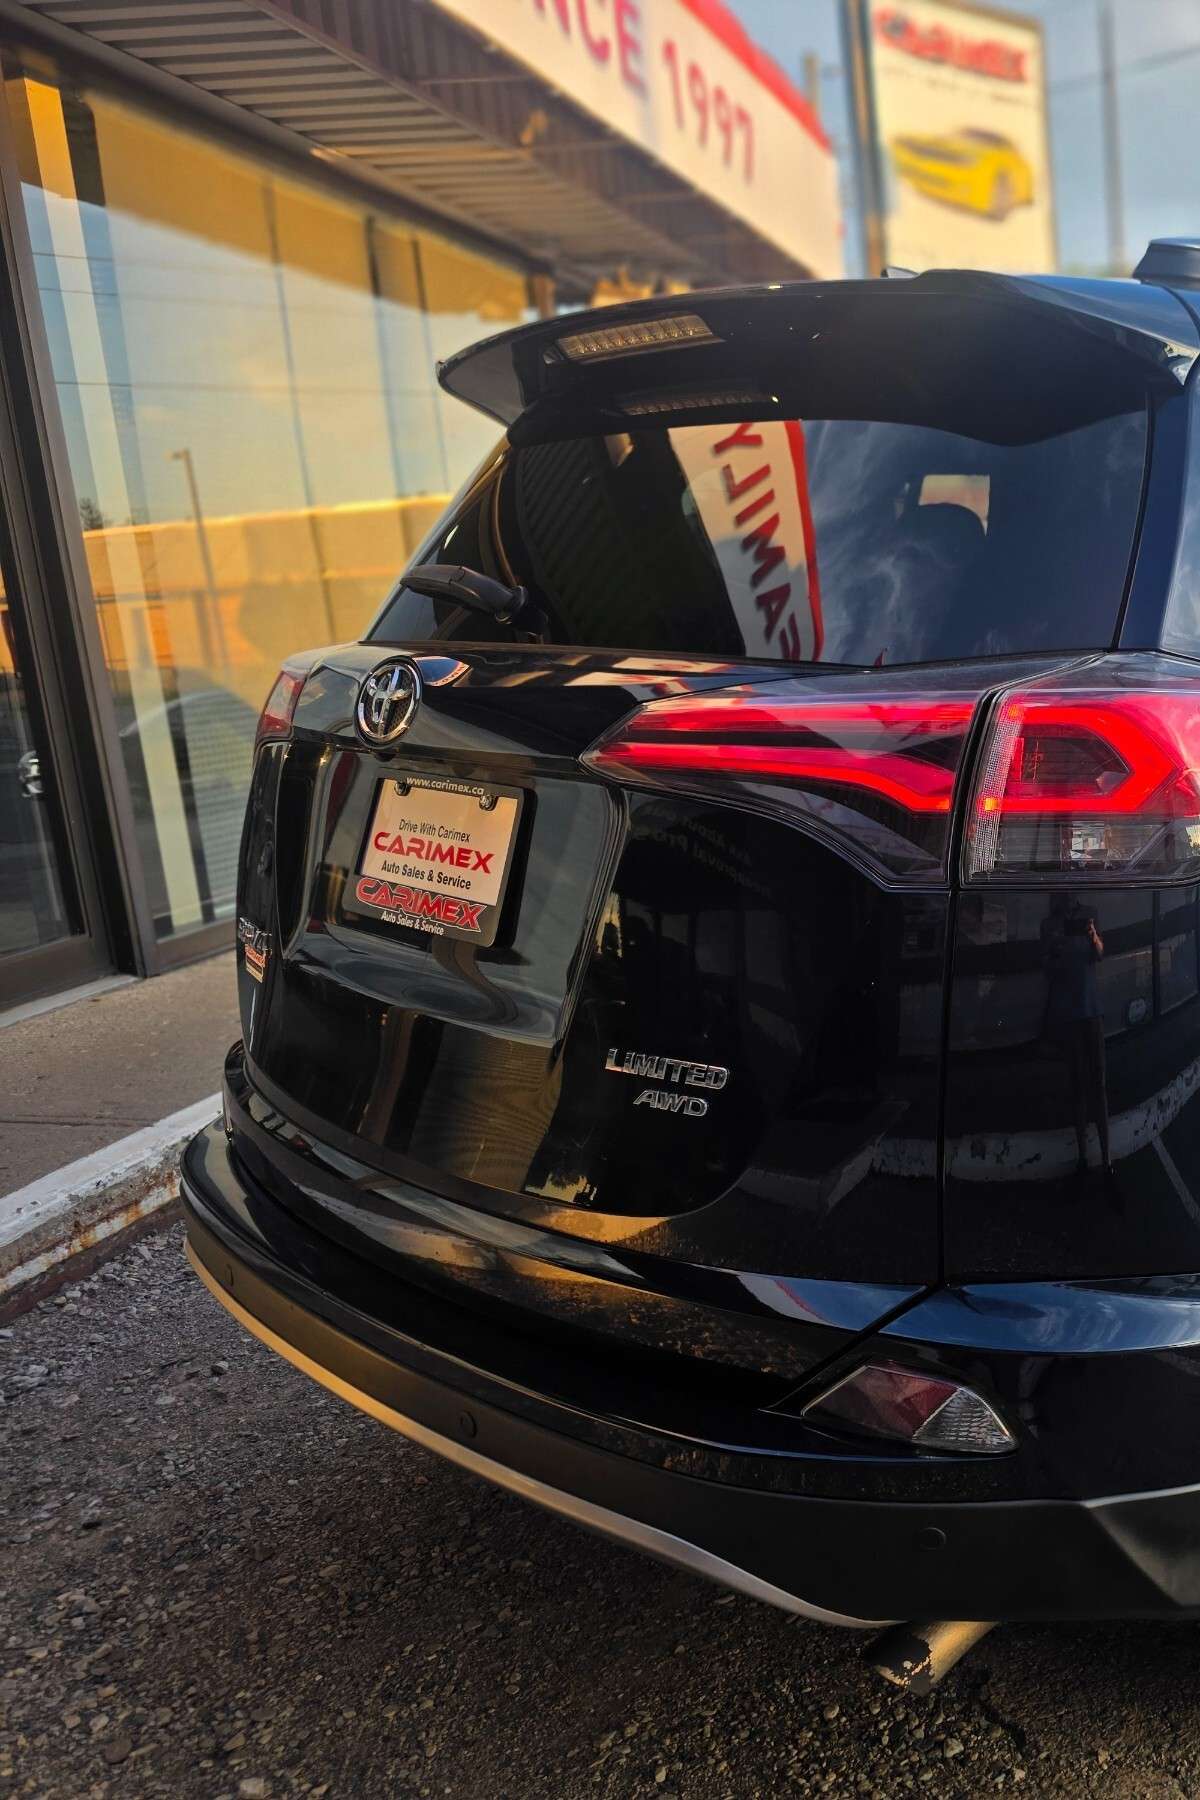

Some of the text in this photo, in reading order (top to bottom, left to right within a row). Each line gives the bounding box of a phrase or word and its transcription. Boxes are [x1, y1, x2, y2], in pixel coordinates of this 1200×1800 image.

[533, 0, 756, 186] CE 1997
[406, 775, 485, 796] www.carimex.ca
[398, 818, 471, 843] Drive With Carimex
[373, 831, 496, 874] CARIMEX
[381, 860, 471, 890] Auto Sales & Service
[356, 876, 487, 932] CARIMEX
[380, 910, 396, 924] Auto
[397, 914, 414, 929] Sales
[420, 919, 445, 936] Service
[604, 1047, 729, 1090] LIMITED
[632, 1088, 709, 1117] AWD
